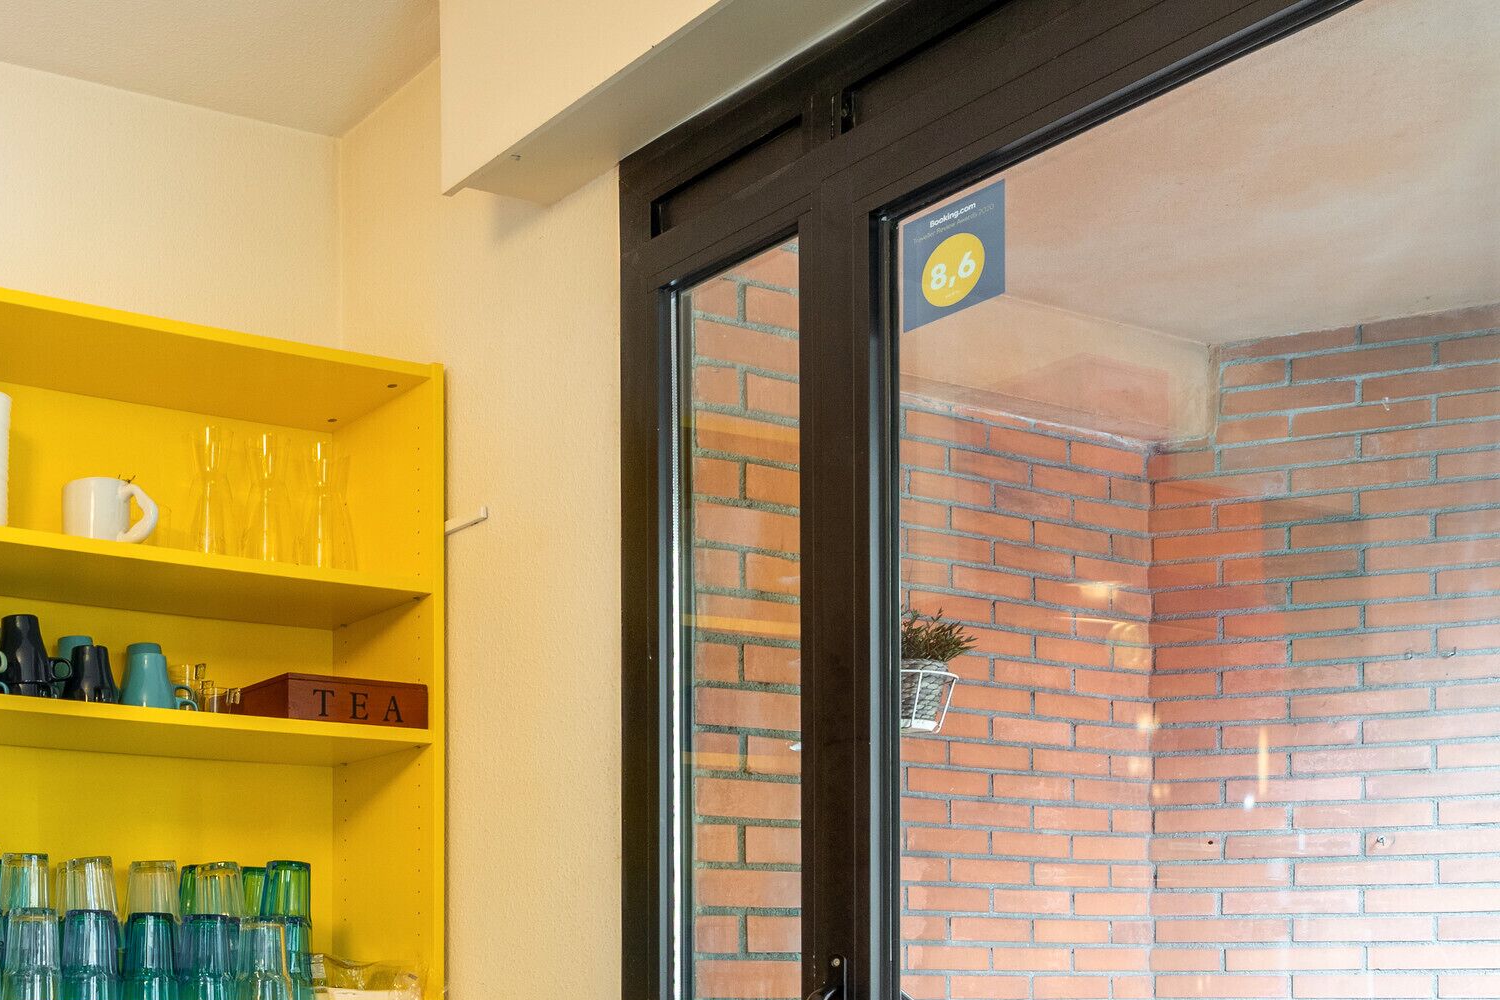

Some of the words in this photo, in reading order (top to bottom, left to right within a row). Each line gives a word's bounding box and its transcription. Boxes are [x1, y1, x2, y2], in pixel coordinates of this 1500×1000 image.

[929, 202, 977, 228] Booking.com
[930, 250, 976, 291] 8,6
[312, 688, 405, 723] TEA
